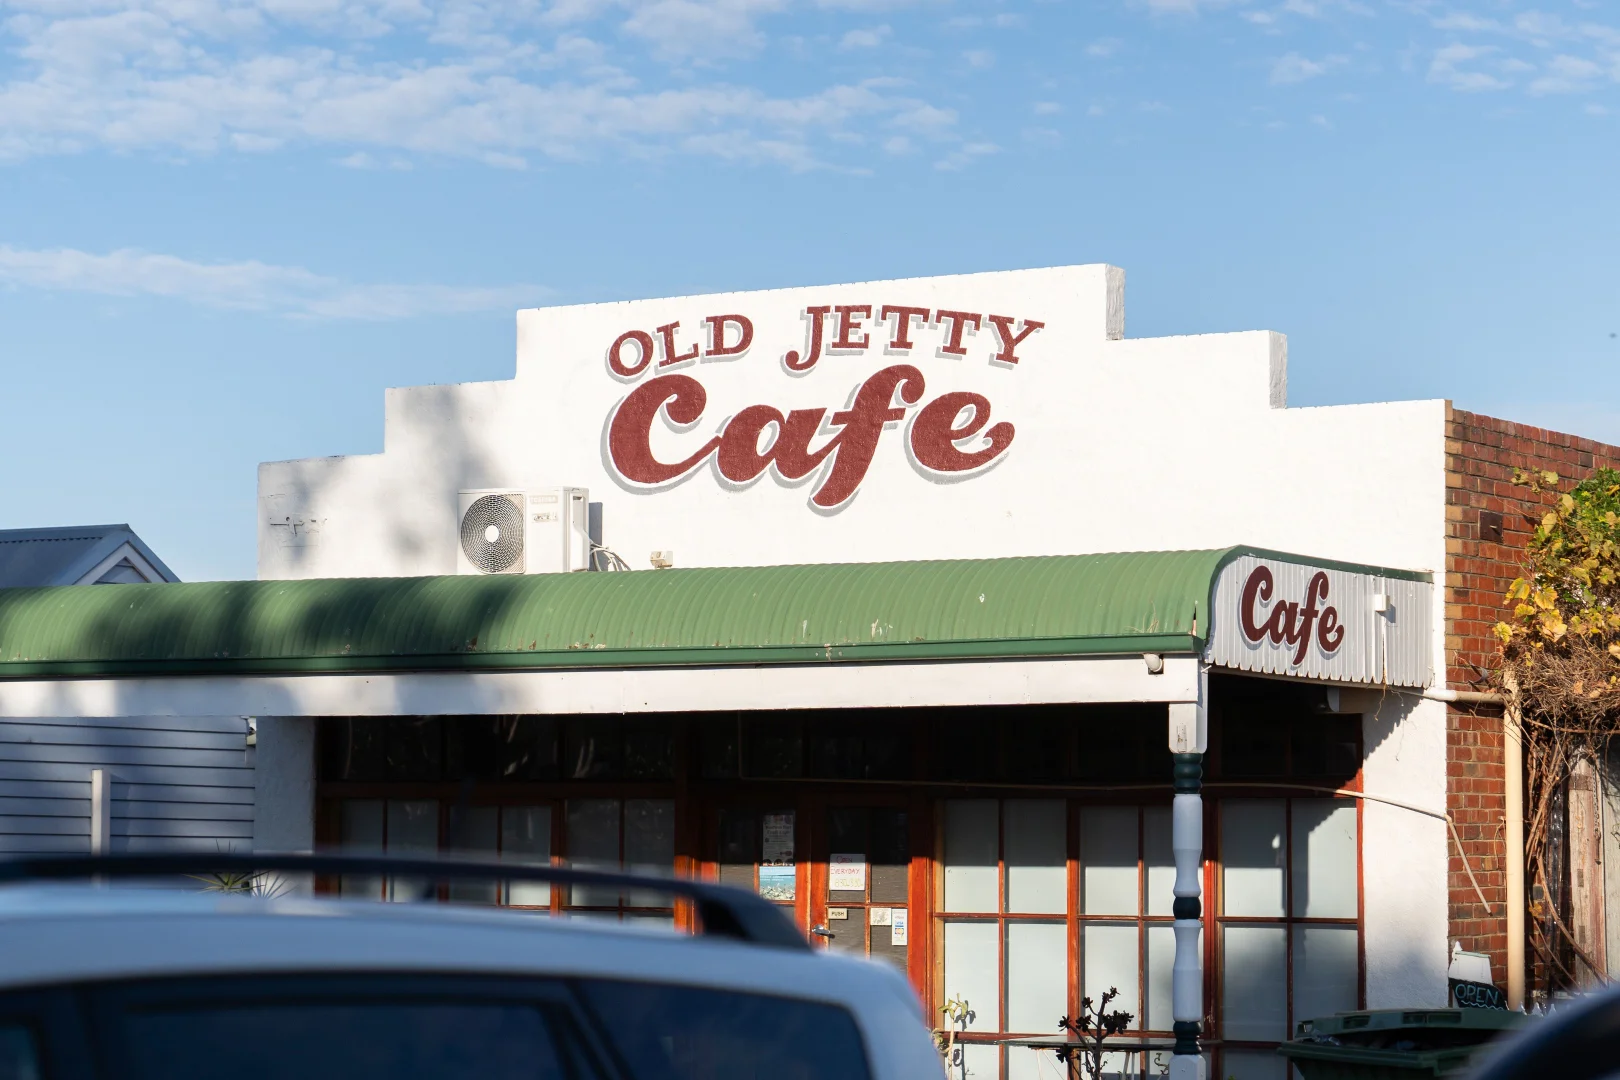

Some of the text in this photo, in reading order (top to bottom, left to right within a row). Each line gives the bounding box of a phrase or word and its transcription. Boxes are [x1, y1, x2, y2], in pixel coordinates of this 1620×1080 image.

[607, 304, 1046, 378] OLD JETTY
[607, 363, 1016, 508] Cafe
[1240, 564, 1346, 667] Cafe
[1455, 983, 1499, 1005] OPEN
